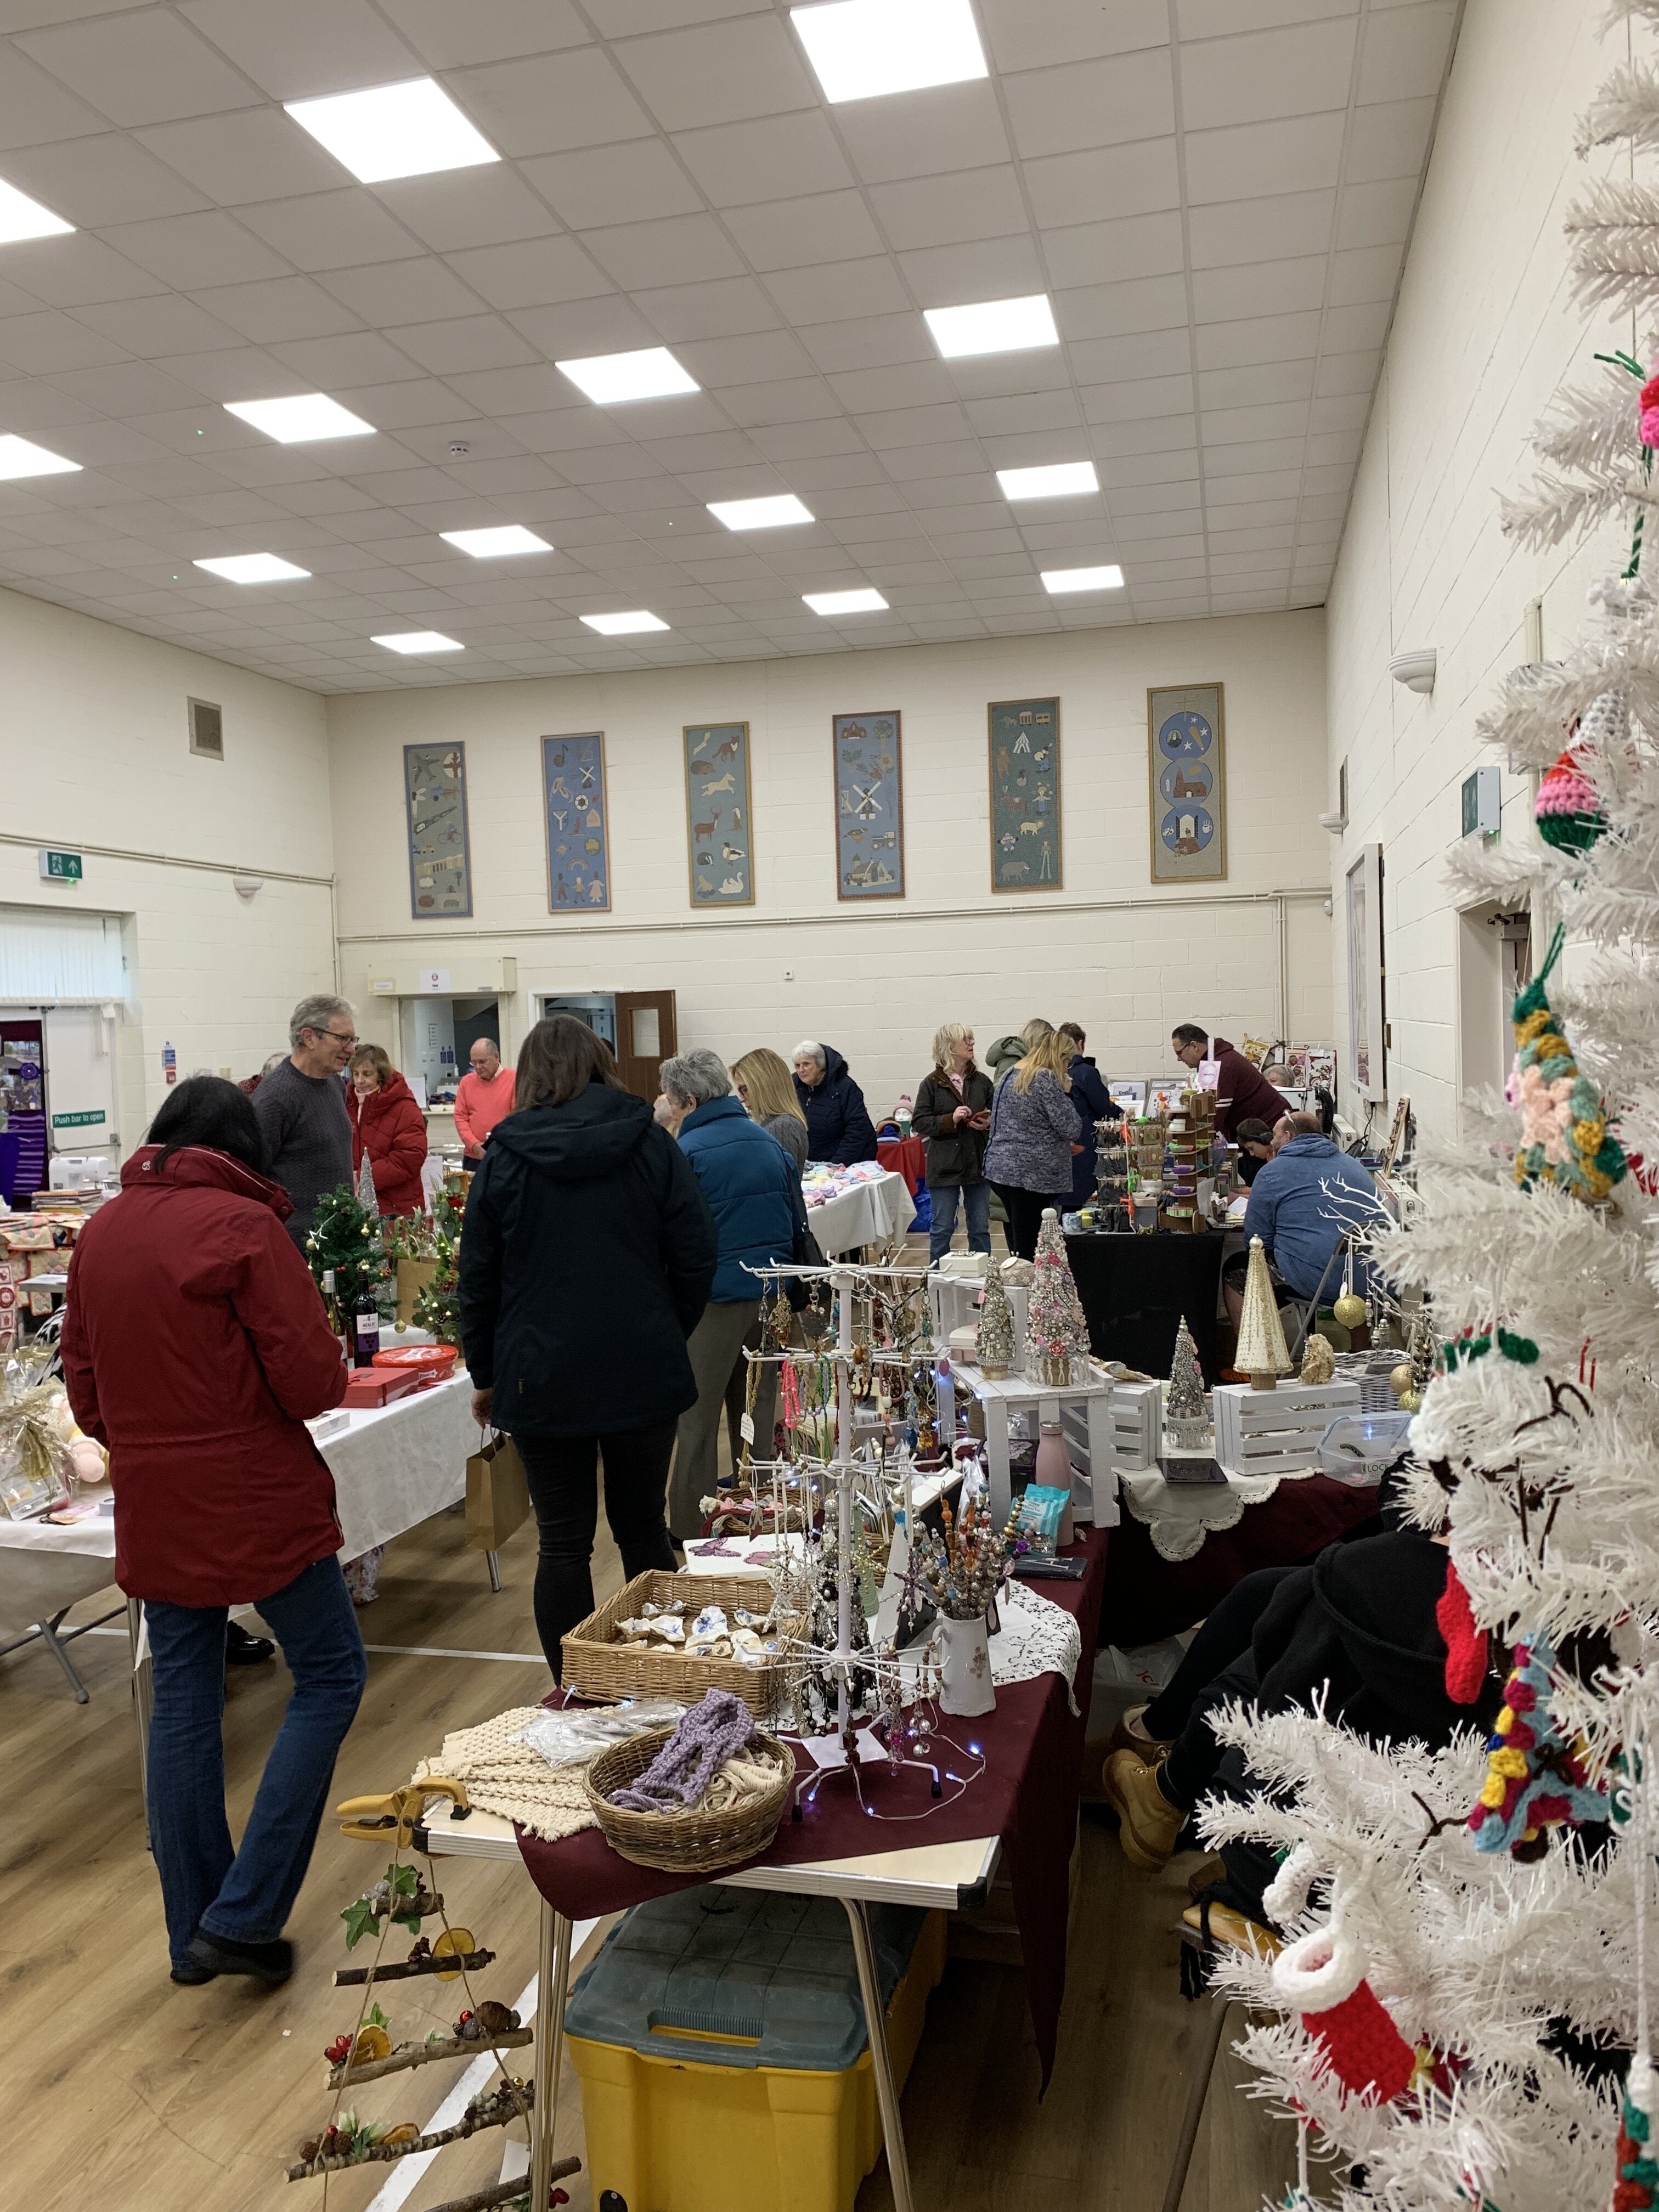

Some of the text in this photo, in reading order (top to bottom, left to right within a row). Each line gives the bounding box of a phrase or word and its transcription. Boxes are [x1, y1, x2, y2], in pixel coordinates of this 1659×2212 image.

[55, 1115, 70, 1124] Push
[71, 1115, 81, 1123] bar
[90, 1113, 103, 1122] open
